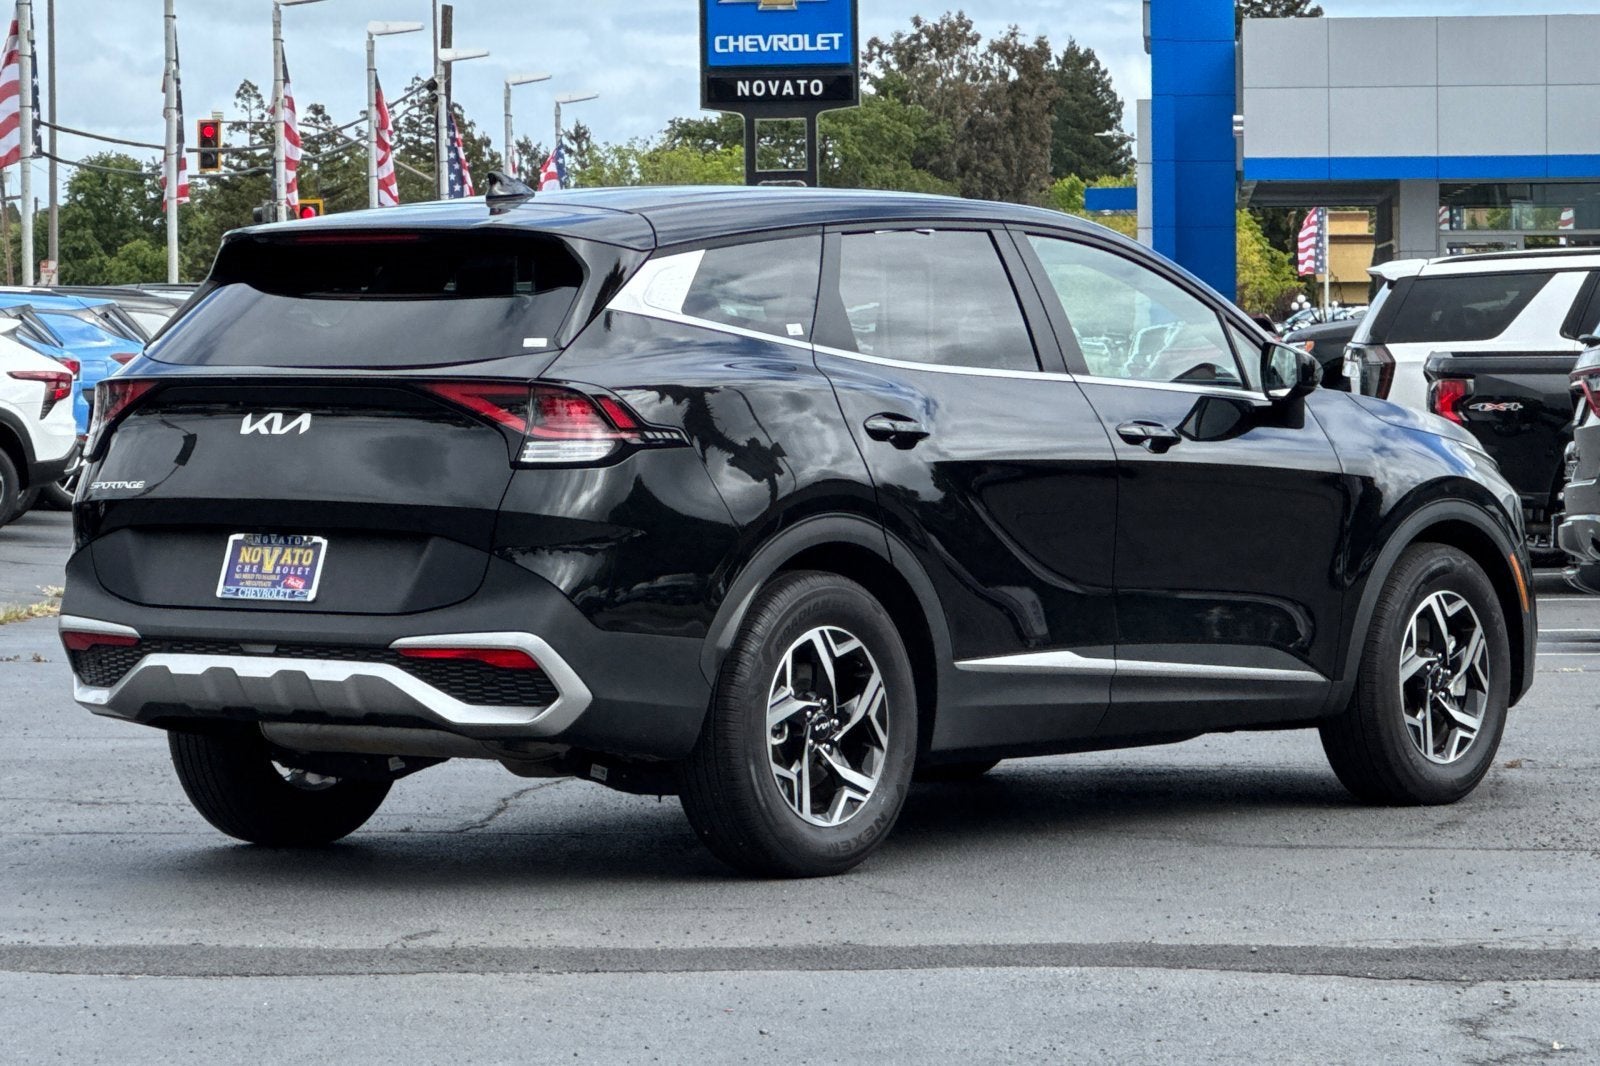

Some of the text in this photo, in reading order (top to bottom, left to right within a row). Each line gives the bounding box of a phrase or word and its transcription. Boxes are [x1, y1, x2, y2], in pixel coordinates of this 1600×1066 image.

[714, 33, 843, 53] CHEVROLET
[737, 79, 823, 97] NOVATO
[240, 412, 312, 434] KIA
[90, 480, 145, 490] SPORTAGE
[254, 535, 301, 545] NOVATO
[238, 546, 314, 573] NOVATO
[238, 587, 291, 599] CHEVROLET
